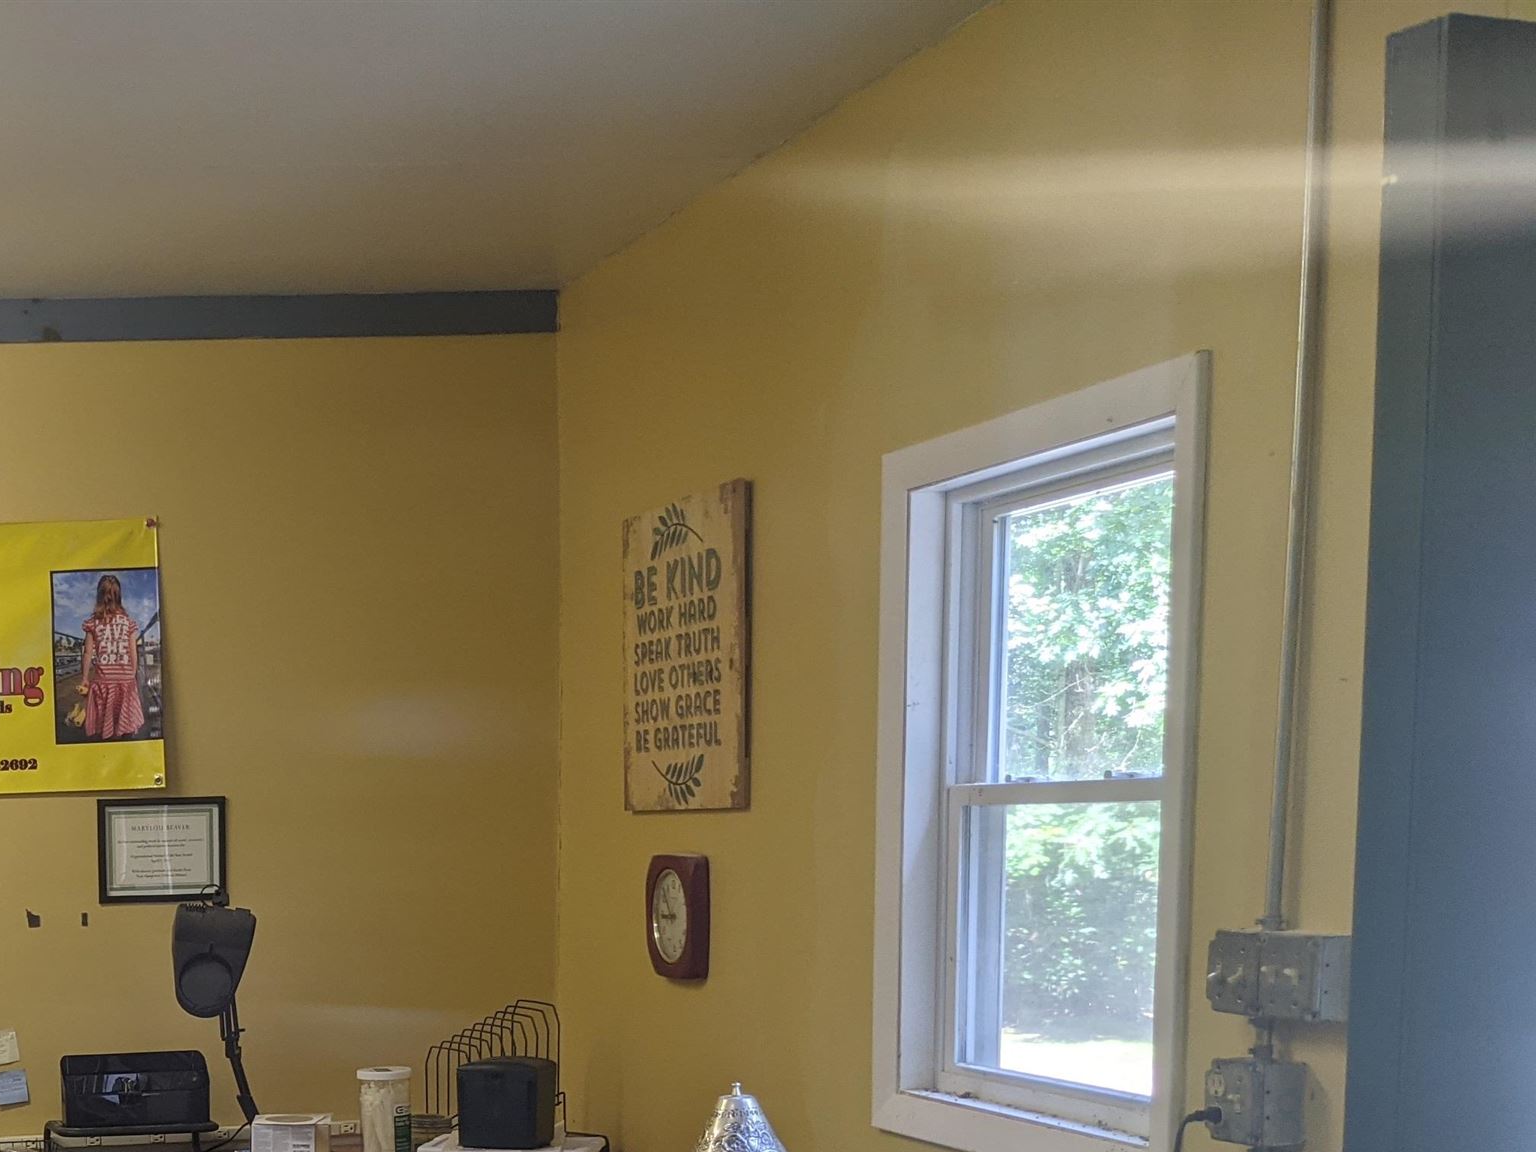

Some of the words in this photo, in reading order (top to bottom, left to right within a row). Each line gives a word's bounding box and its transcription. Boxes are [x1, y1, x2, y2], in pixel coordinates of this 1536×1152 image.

[633, 565, 658, 609] BE
[666, 548, 722, 600] KIND
[637, 605, 673, 637] WORK
[678, 595, 716, 627] HARD
[634, 634, 673, 666] SPEAK
[675, 626, 721, 659] TRUTH
[634, 666, 665, 697] LOVE
[669, 657, 722, 689] OTHERS
[634, 696, 670, 725] SHOW
[675, 688, 721, 719] GRACE
[635, 729, 650, 754] BE
[654, 720, 722, 752] GRATEFUL
